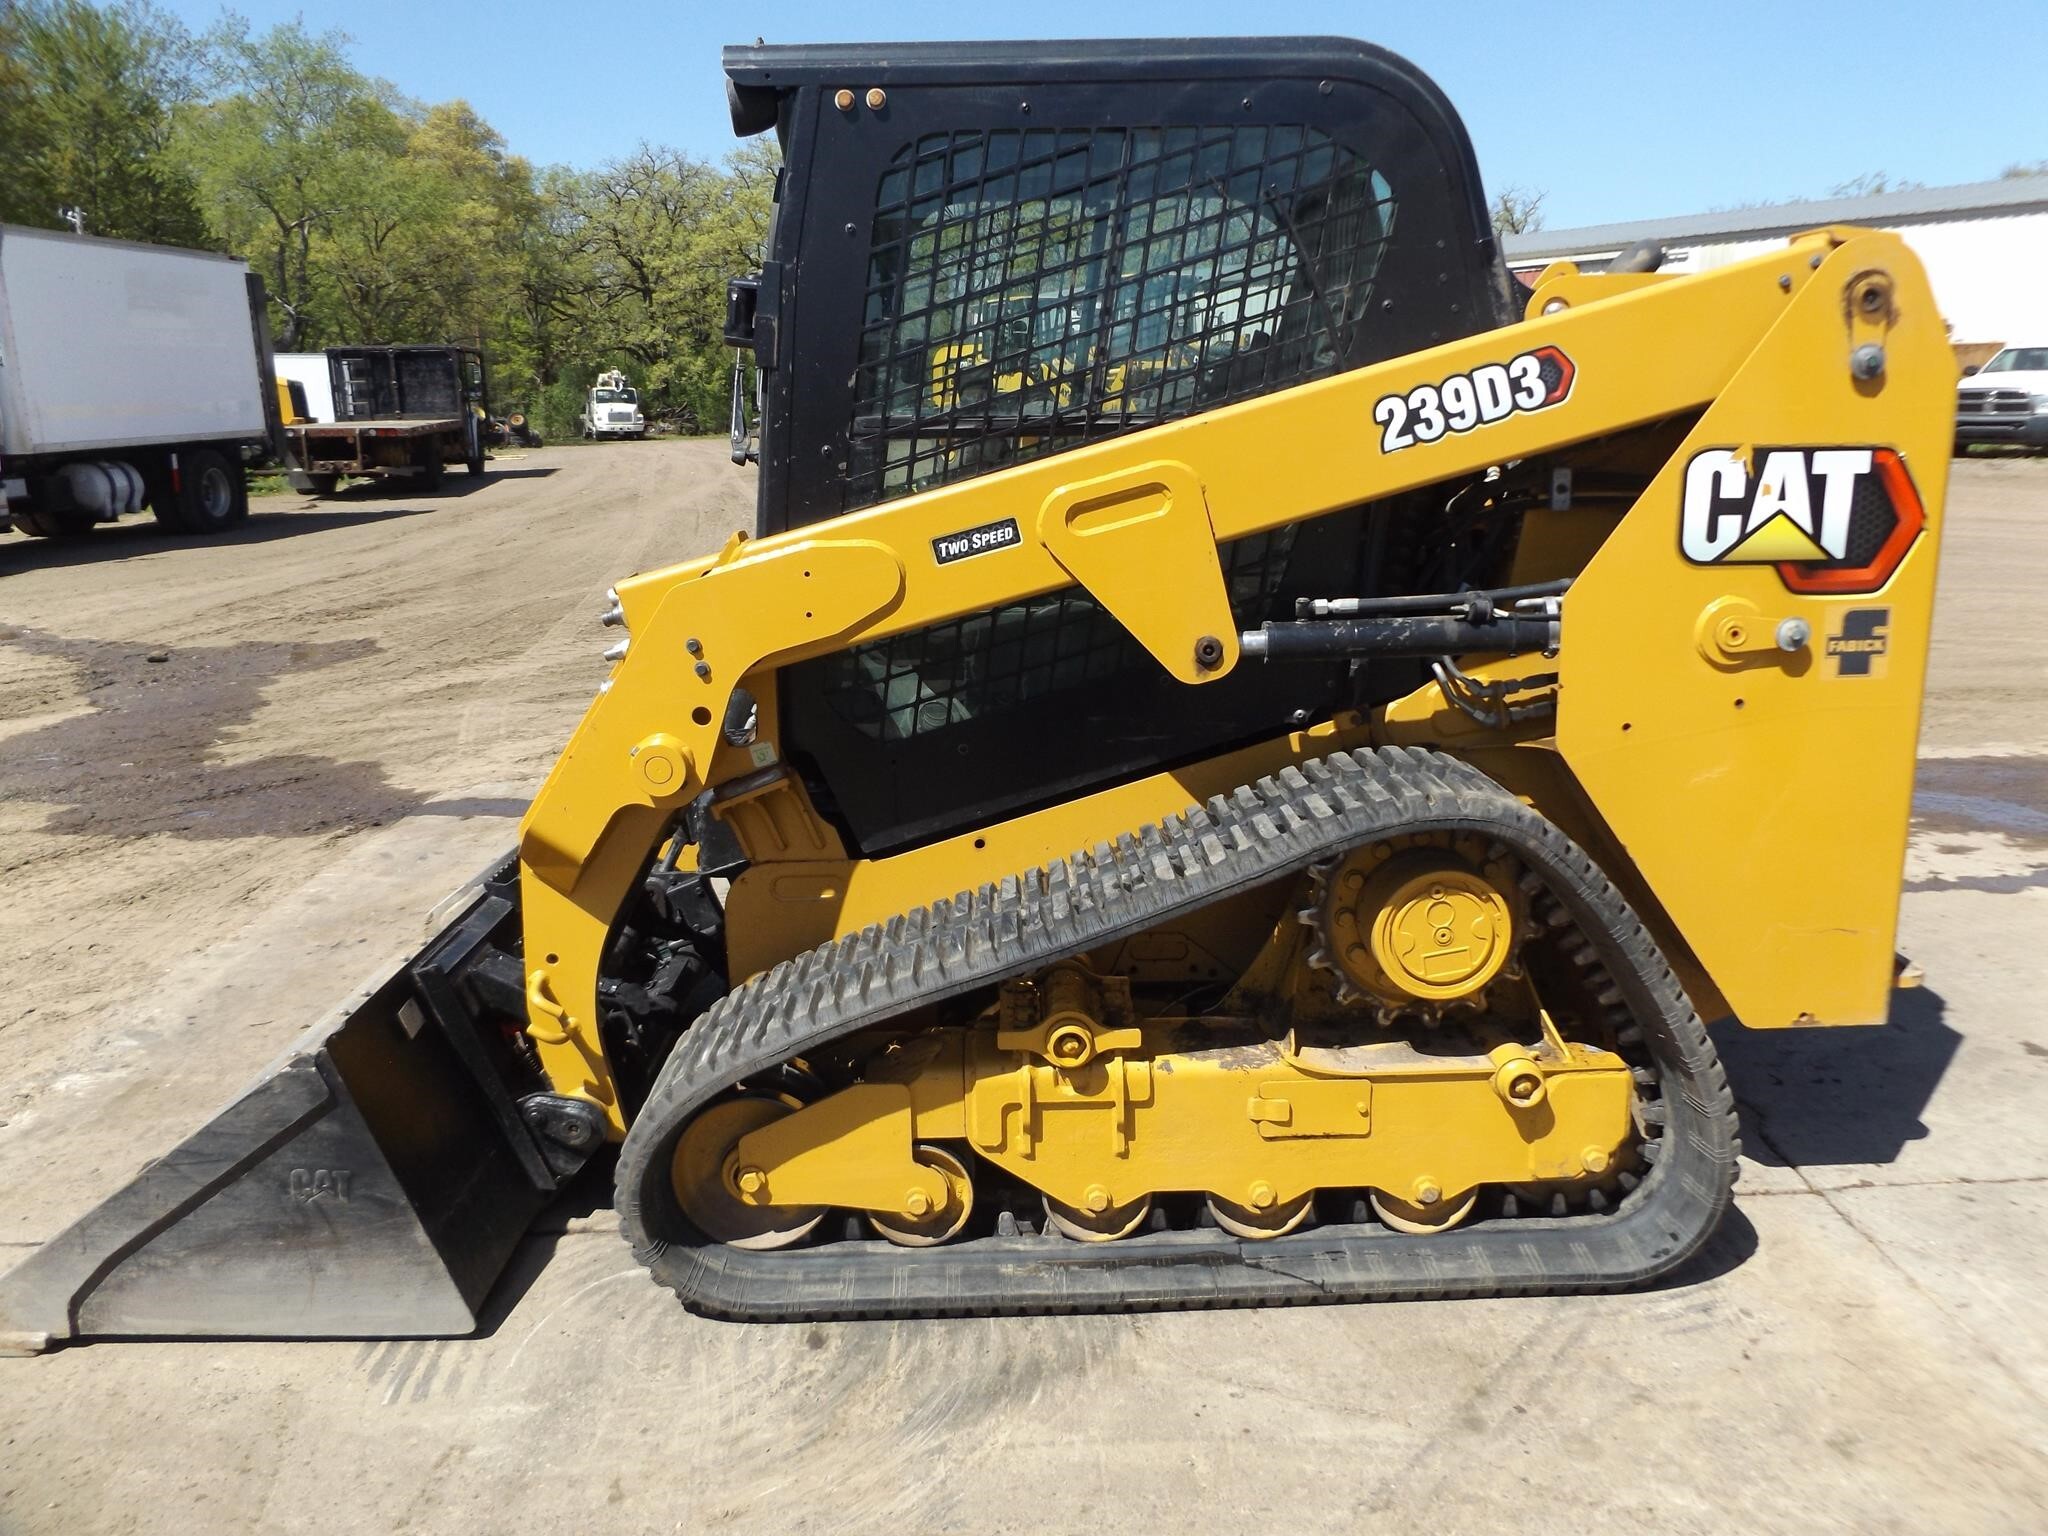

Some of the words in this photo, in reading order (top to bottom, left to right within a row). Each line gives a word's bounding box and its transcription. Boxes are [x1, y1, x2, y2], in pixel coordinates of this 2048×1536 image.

[1375, 355, 1547, 452] 239D3
[1682, 450, 1872, 562] CAT
[1828, 640, 1885, 653] FABICK
[289, 1168, 351, 1204] CAT
